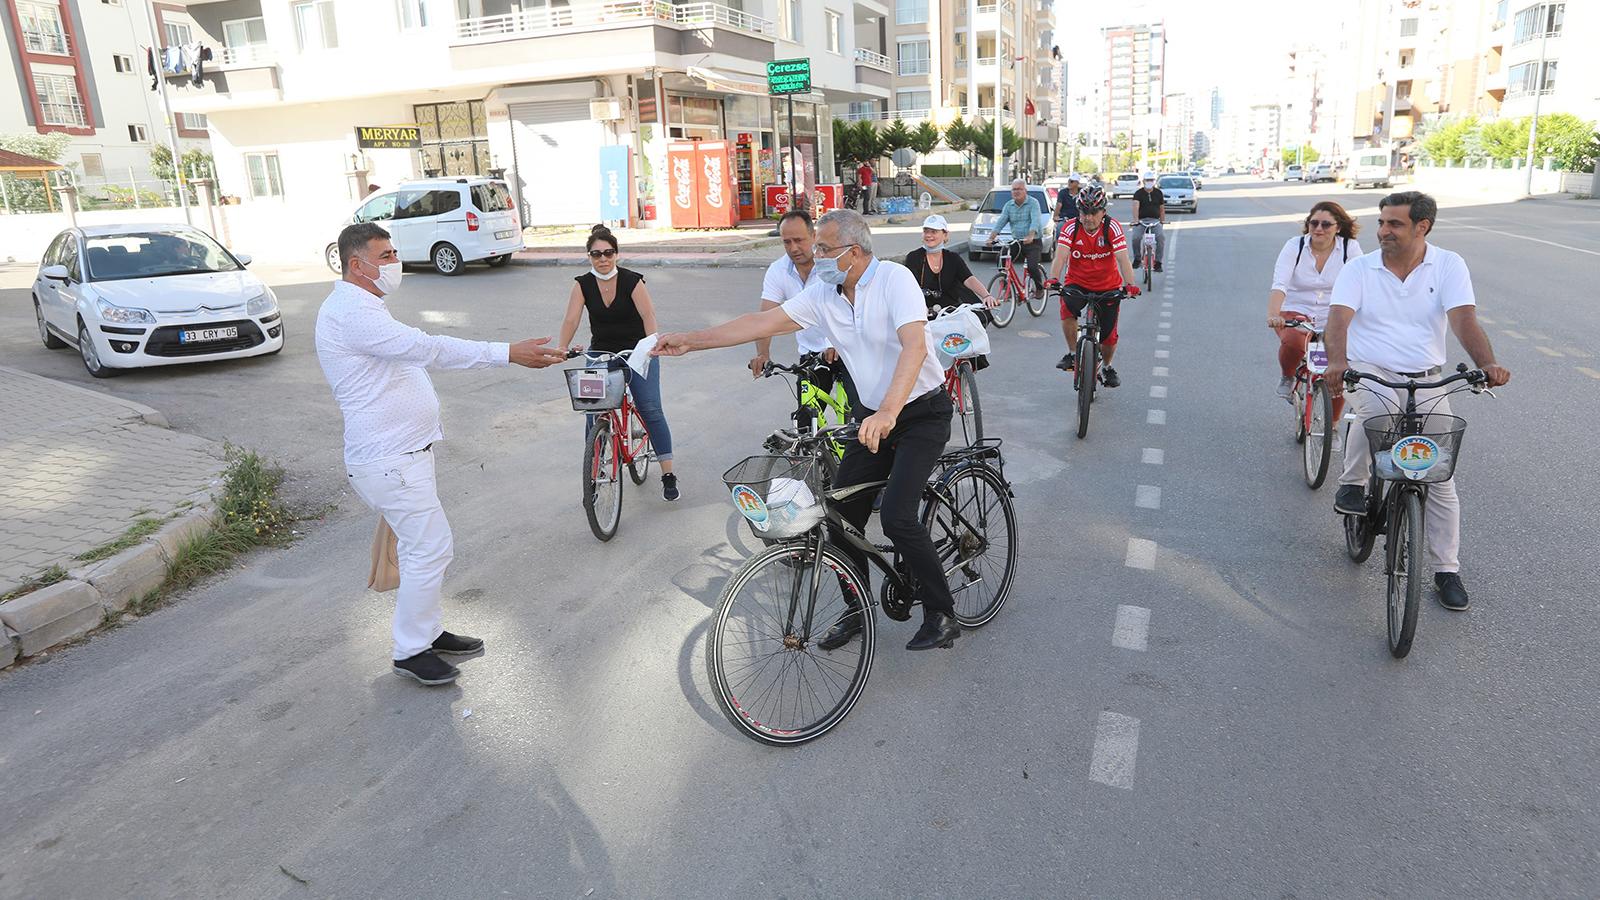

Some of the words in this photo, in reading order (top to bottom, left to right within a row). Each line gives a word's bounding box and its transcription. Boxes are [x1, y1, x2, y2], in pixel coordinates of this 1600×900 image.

[360, 128, 418, 140] MERYAR
[607, 170, 620, 207] pepsi
[704, 154, 723, 209] Coca-Cola
[186, 332, 196, 340] 33
[203, 330, 219, 338] CRY
[226, 328, 237, 336] 05
